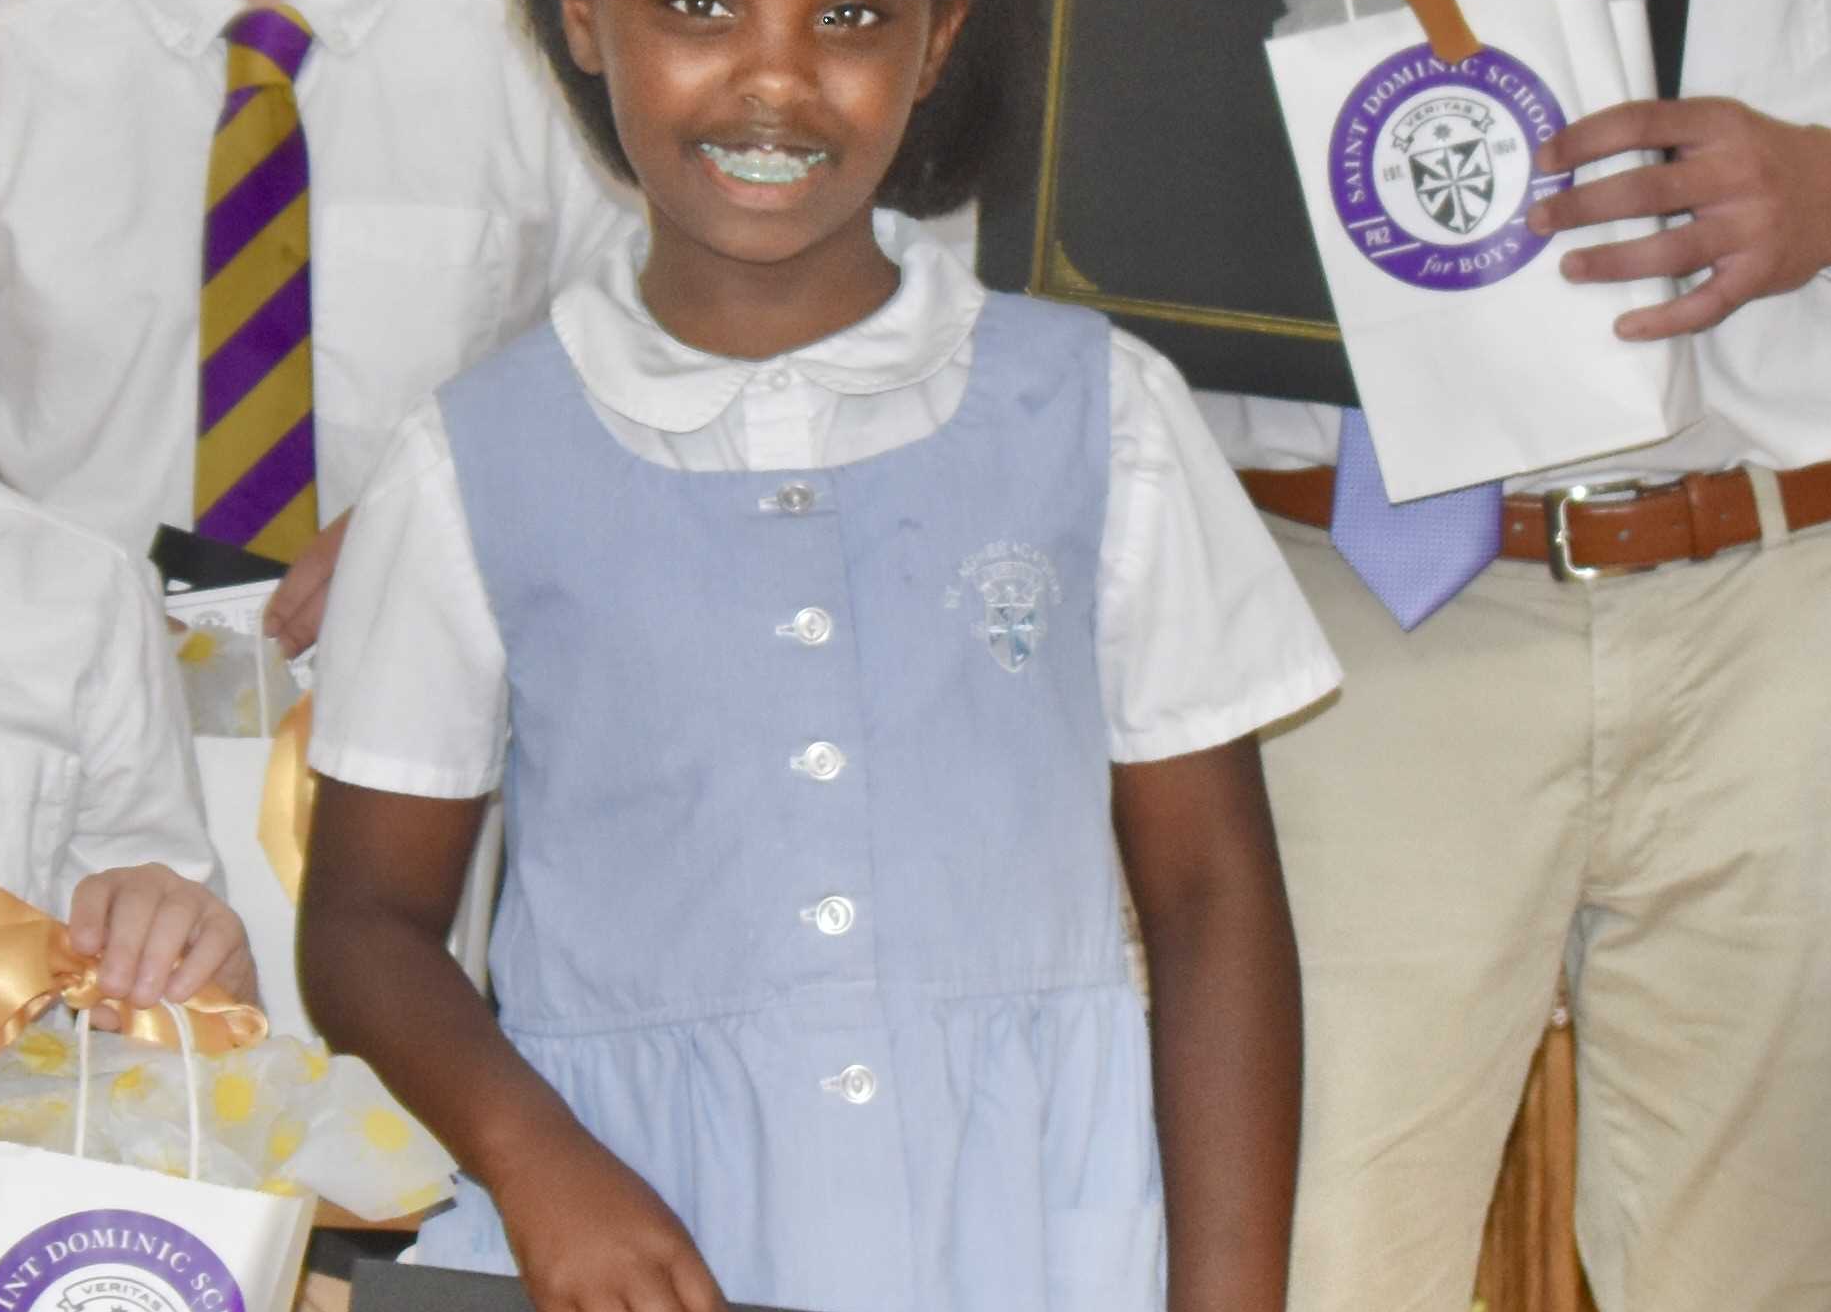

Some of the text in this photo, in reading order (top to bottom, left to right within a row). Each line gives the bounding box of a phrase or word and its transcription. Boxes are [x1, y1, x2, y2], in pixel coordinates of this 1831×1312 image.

[1343, 118, 1368, 204] SAINT
[1484, 64, 1555, 142] SCHOO
[1419, 238, 1521, 276] for BOYS
[45, 1227, 192, 1273] DOMINIC
[80, 1280, 163, 1312] VERITAS
